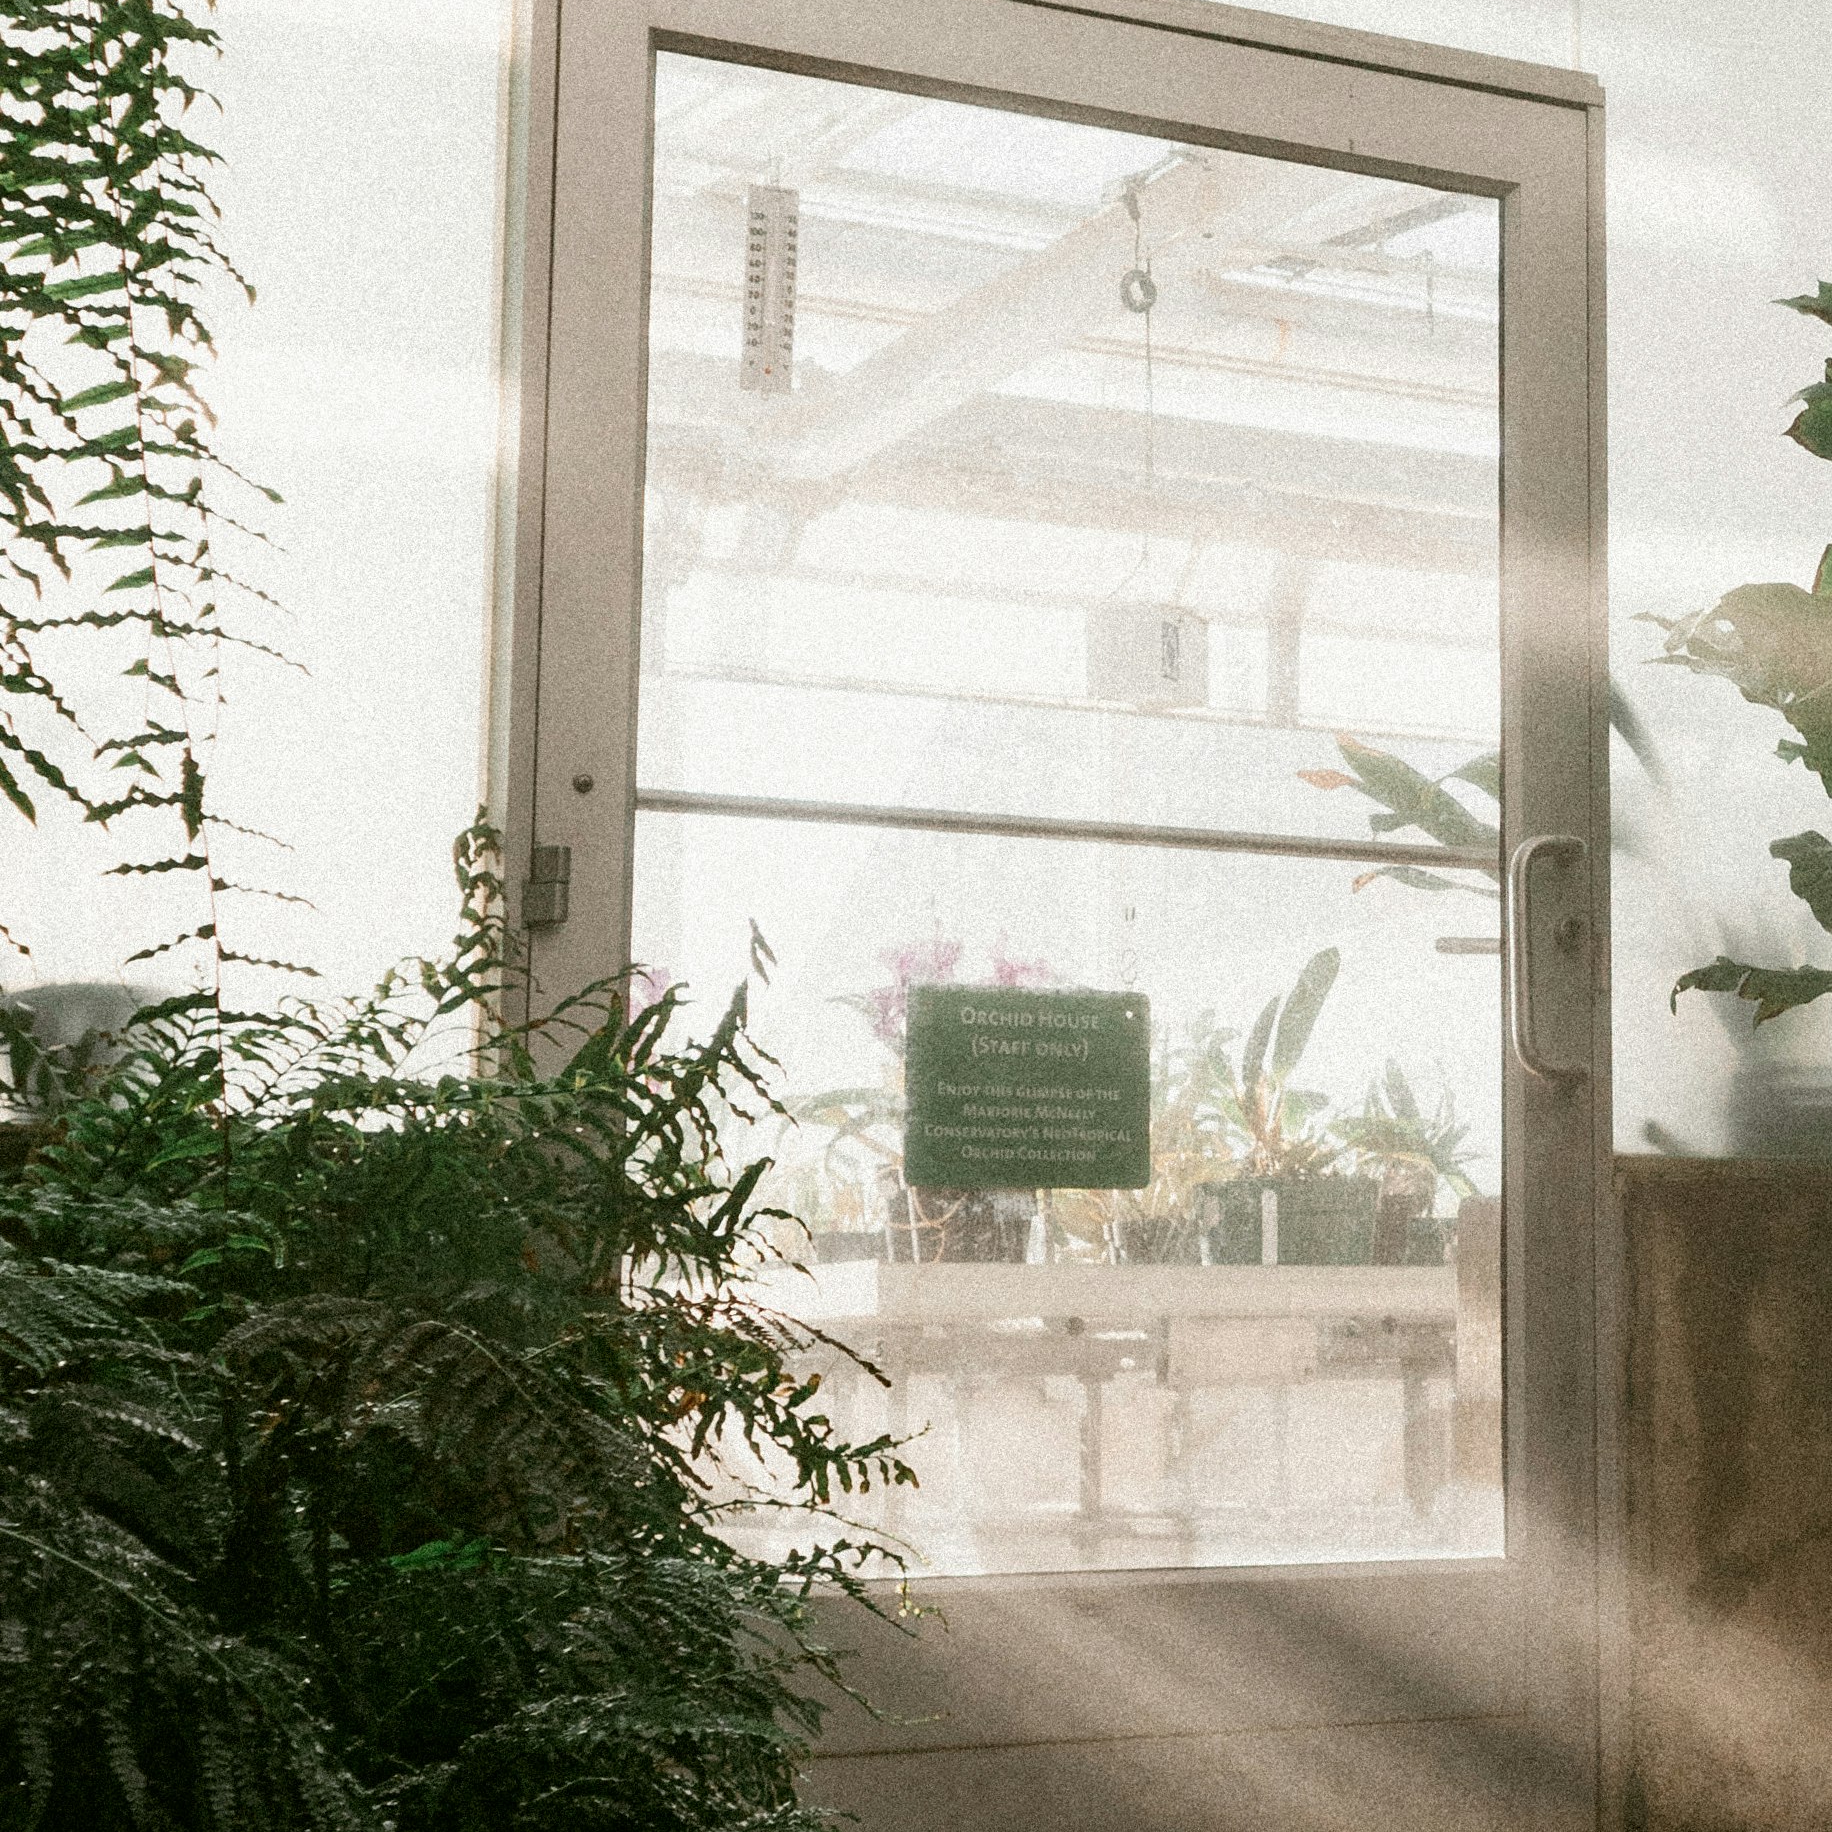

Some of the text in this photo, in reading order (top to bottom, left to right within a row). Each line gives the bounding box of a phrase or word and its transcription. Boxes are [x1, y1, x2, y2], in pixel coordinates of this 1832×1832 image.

[960, 1006, 1099, 1029] ORCHID HOUSE
[972, 1034, 1088, 1061] (STAFF ONLY)
[961, 1144, 1014, 1160] ORCHID
